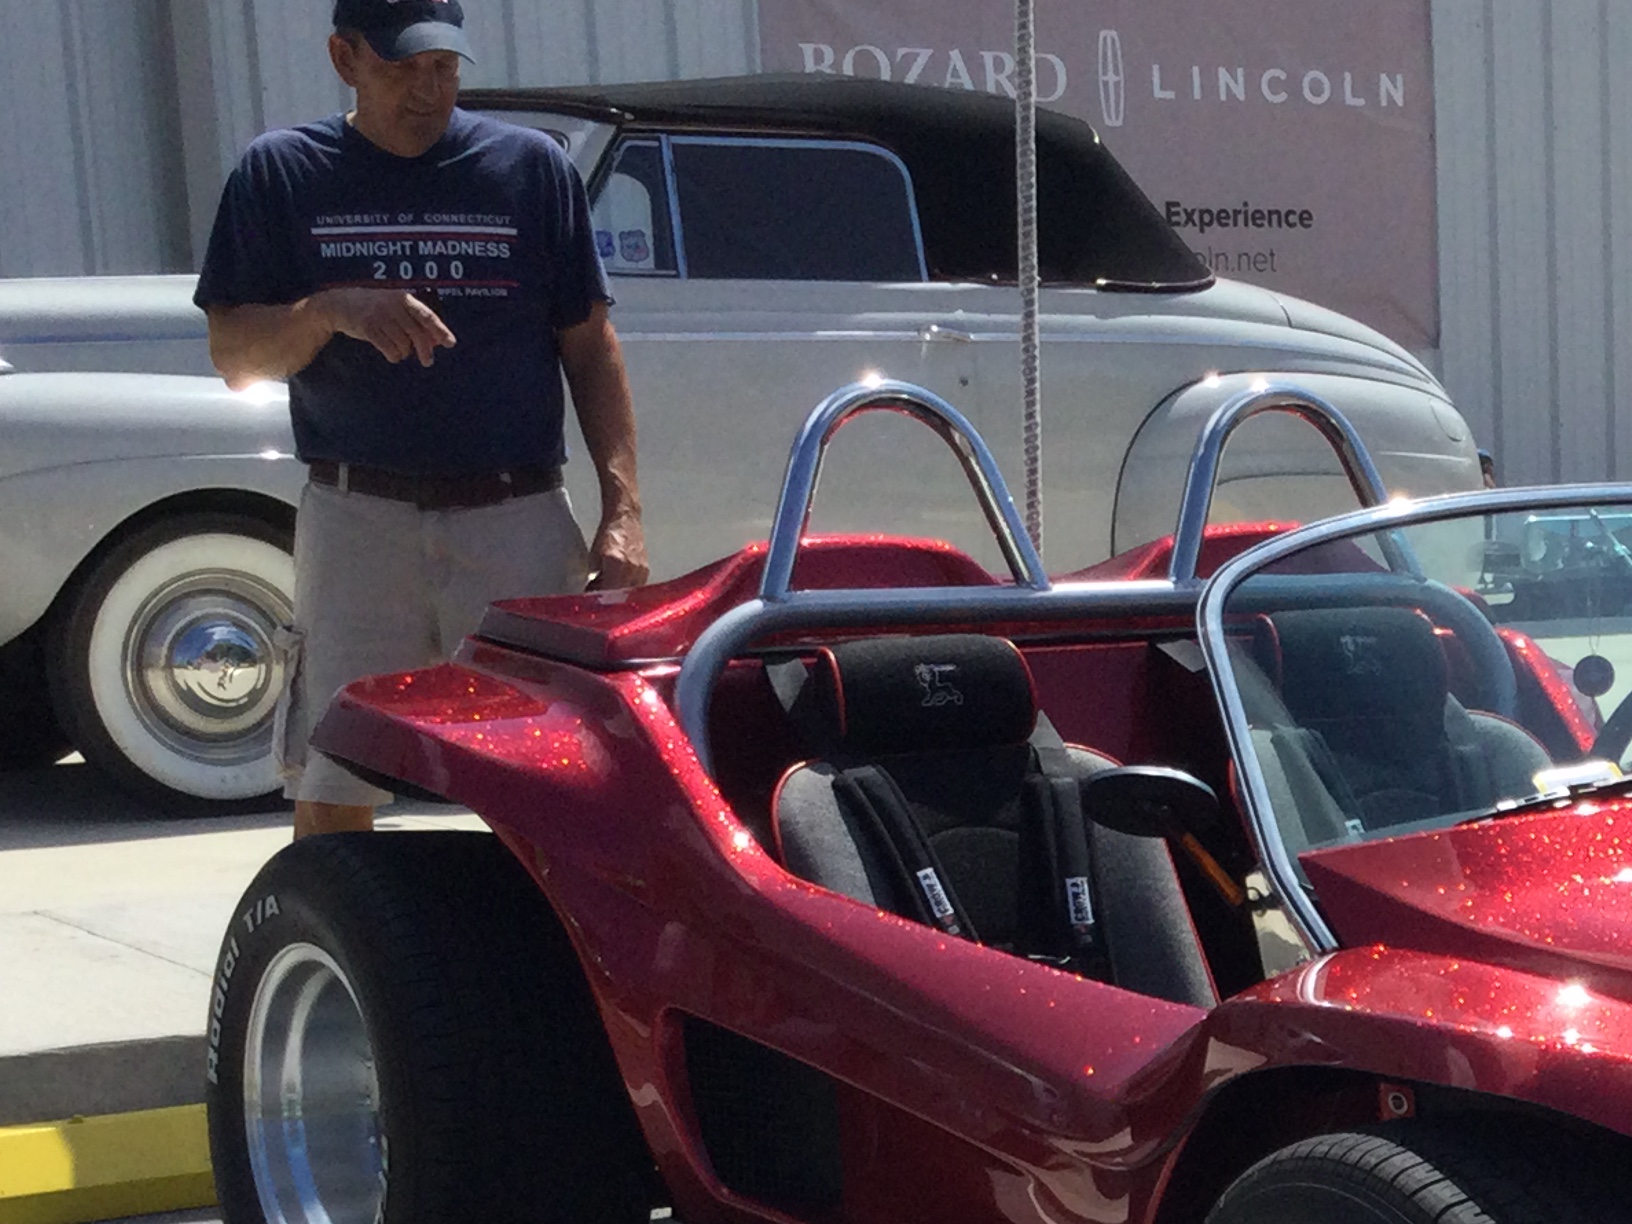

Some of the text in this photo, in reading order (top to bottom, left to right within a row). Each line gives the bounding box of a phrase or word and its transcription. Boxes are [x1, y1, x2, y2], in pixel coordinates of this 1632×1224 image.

[1152, 63, 1404, 107] LINCOLN
[316, 213, 512, 226] UNIVERSITY OF CONNECTICUT
[1165, 201, 1314, 234] Experience
[320, 240, 511, 259] MIDNIGHT MADNESS
[243, 894, 280, 933] T/A
